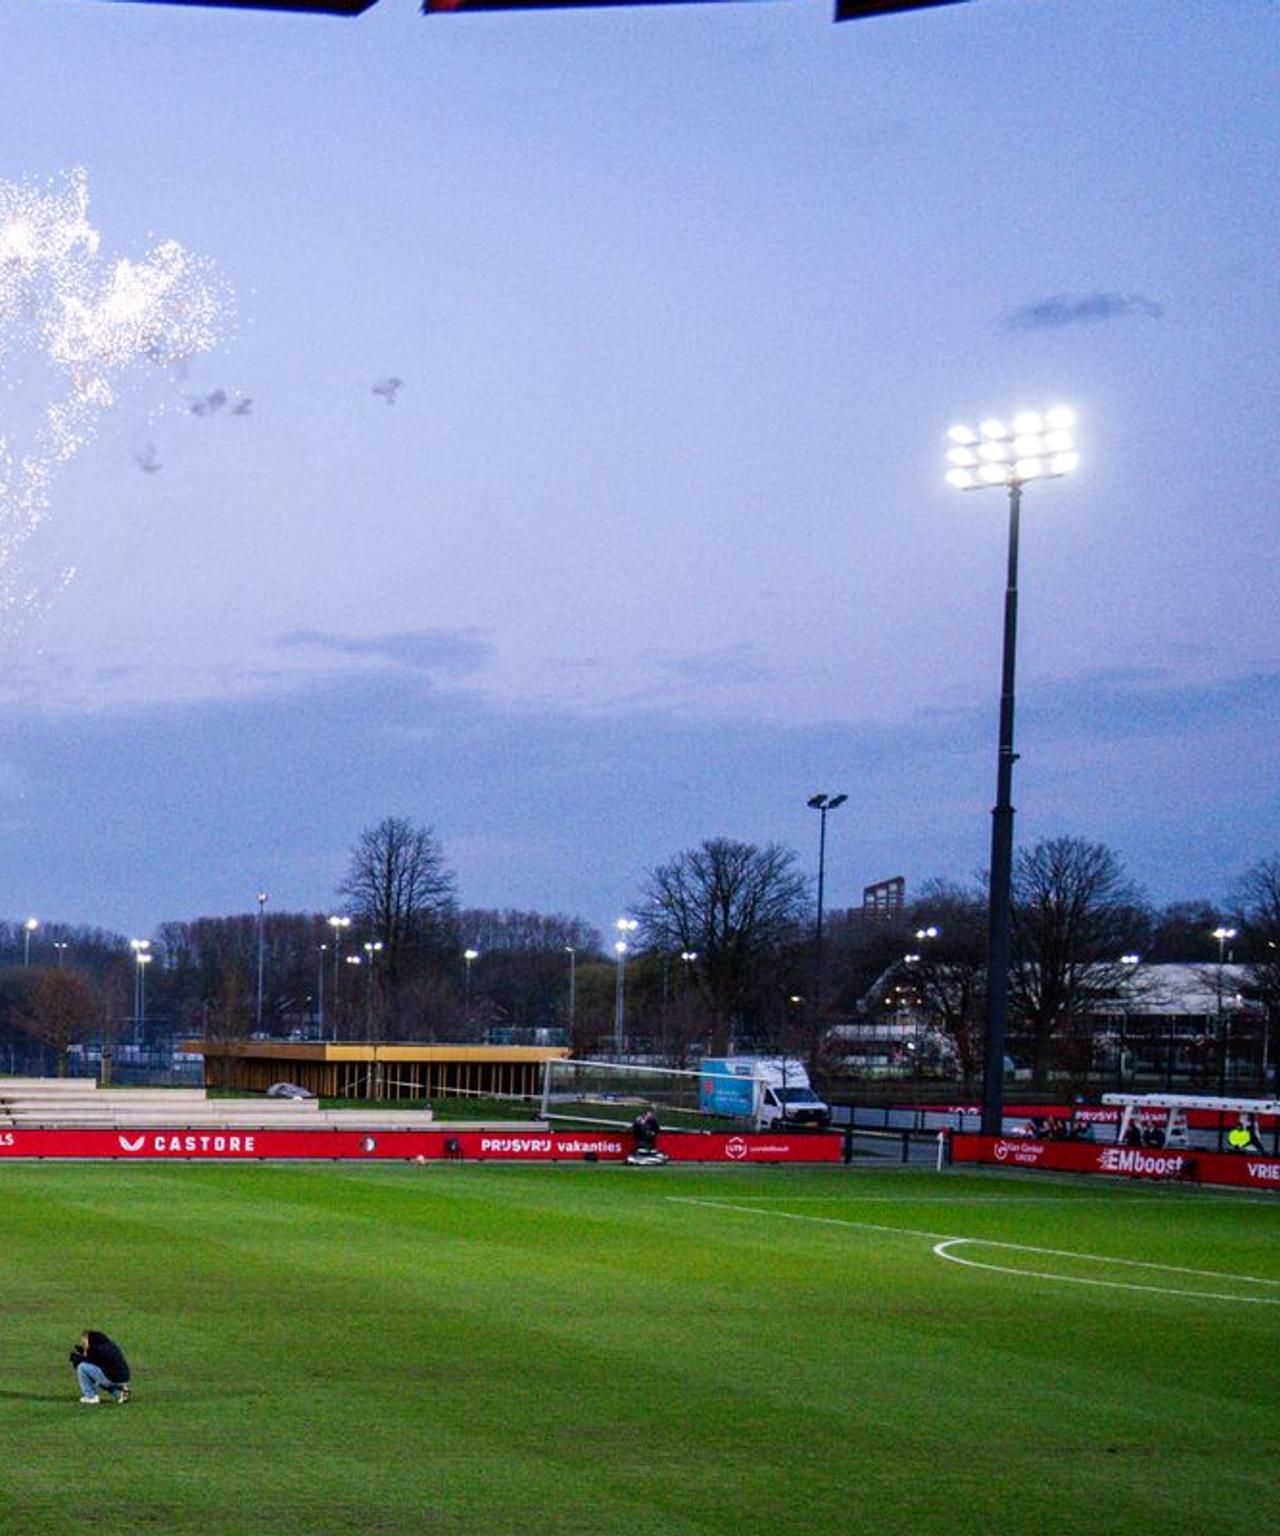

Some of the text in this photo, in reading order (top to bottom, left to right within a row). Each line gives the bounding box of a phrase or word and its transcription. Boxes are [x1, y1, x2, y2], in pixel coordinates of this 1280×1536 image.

[155, 1137, 254, 1151] CASTORE
[558, 1141, 621, 1152] vakanties
[1107, 1148, 1184, 1174] EMboost
